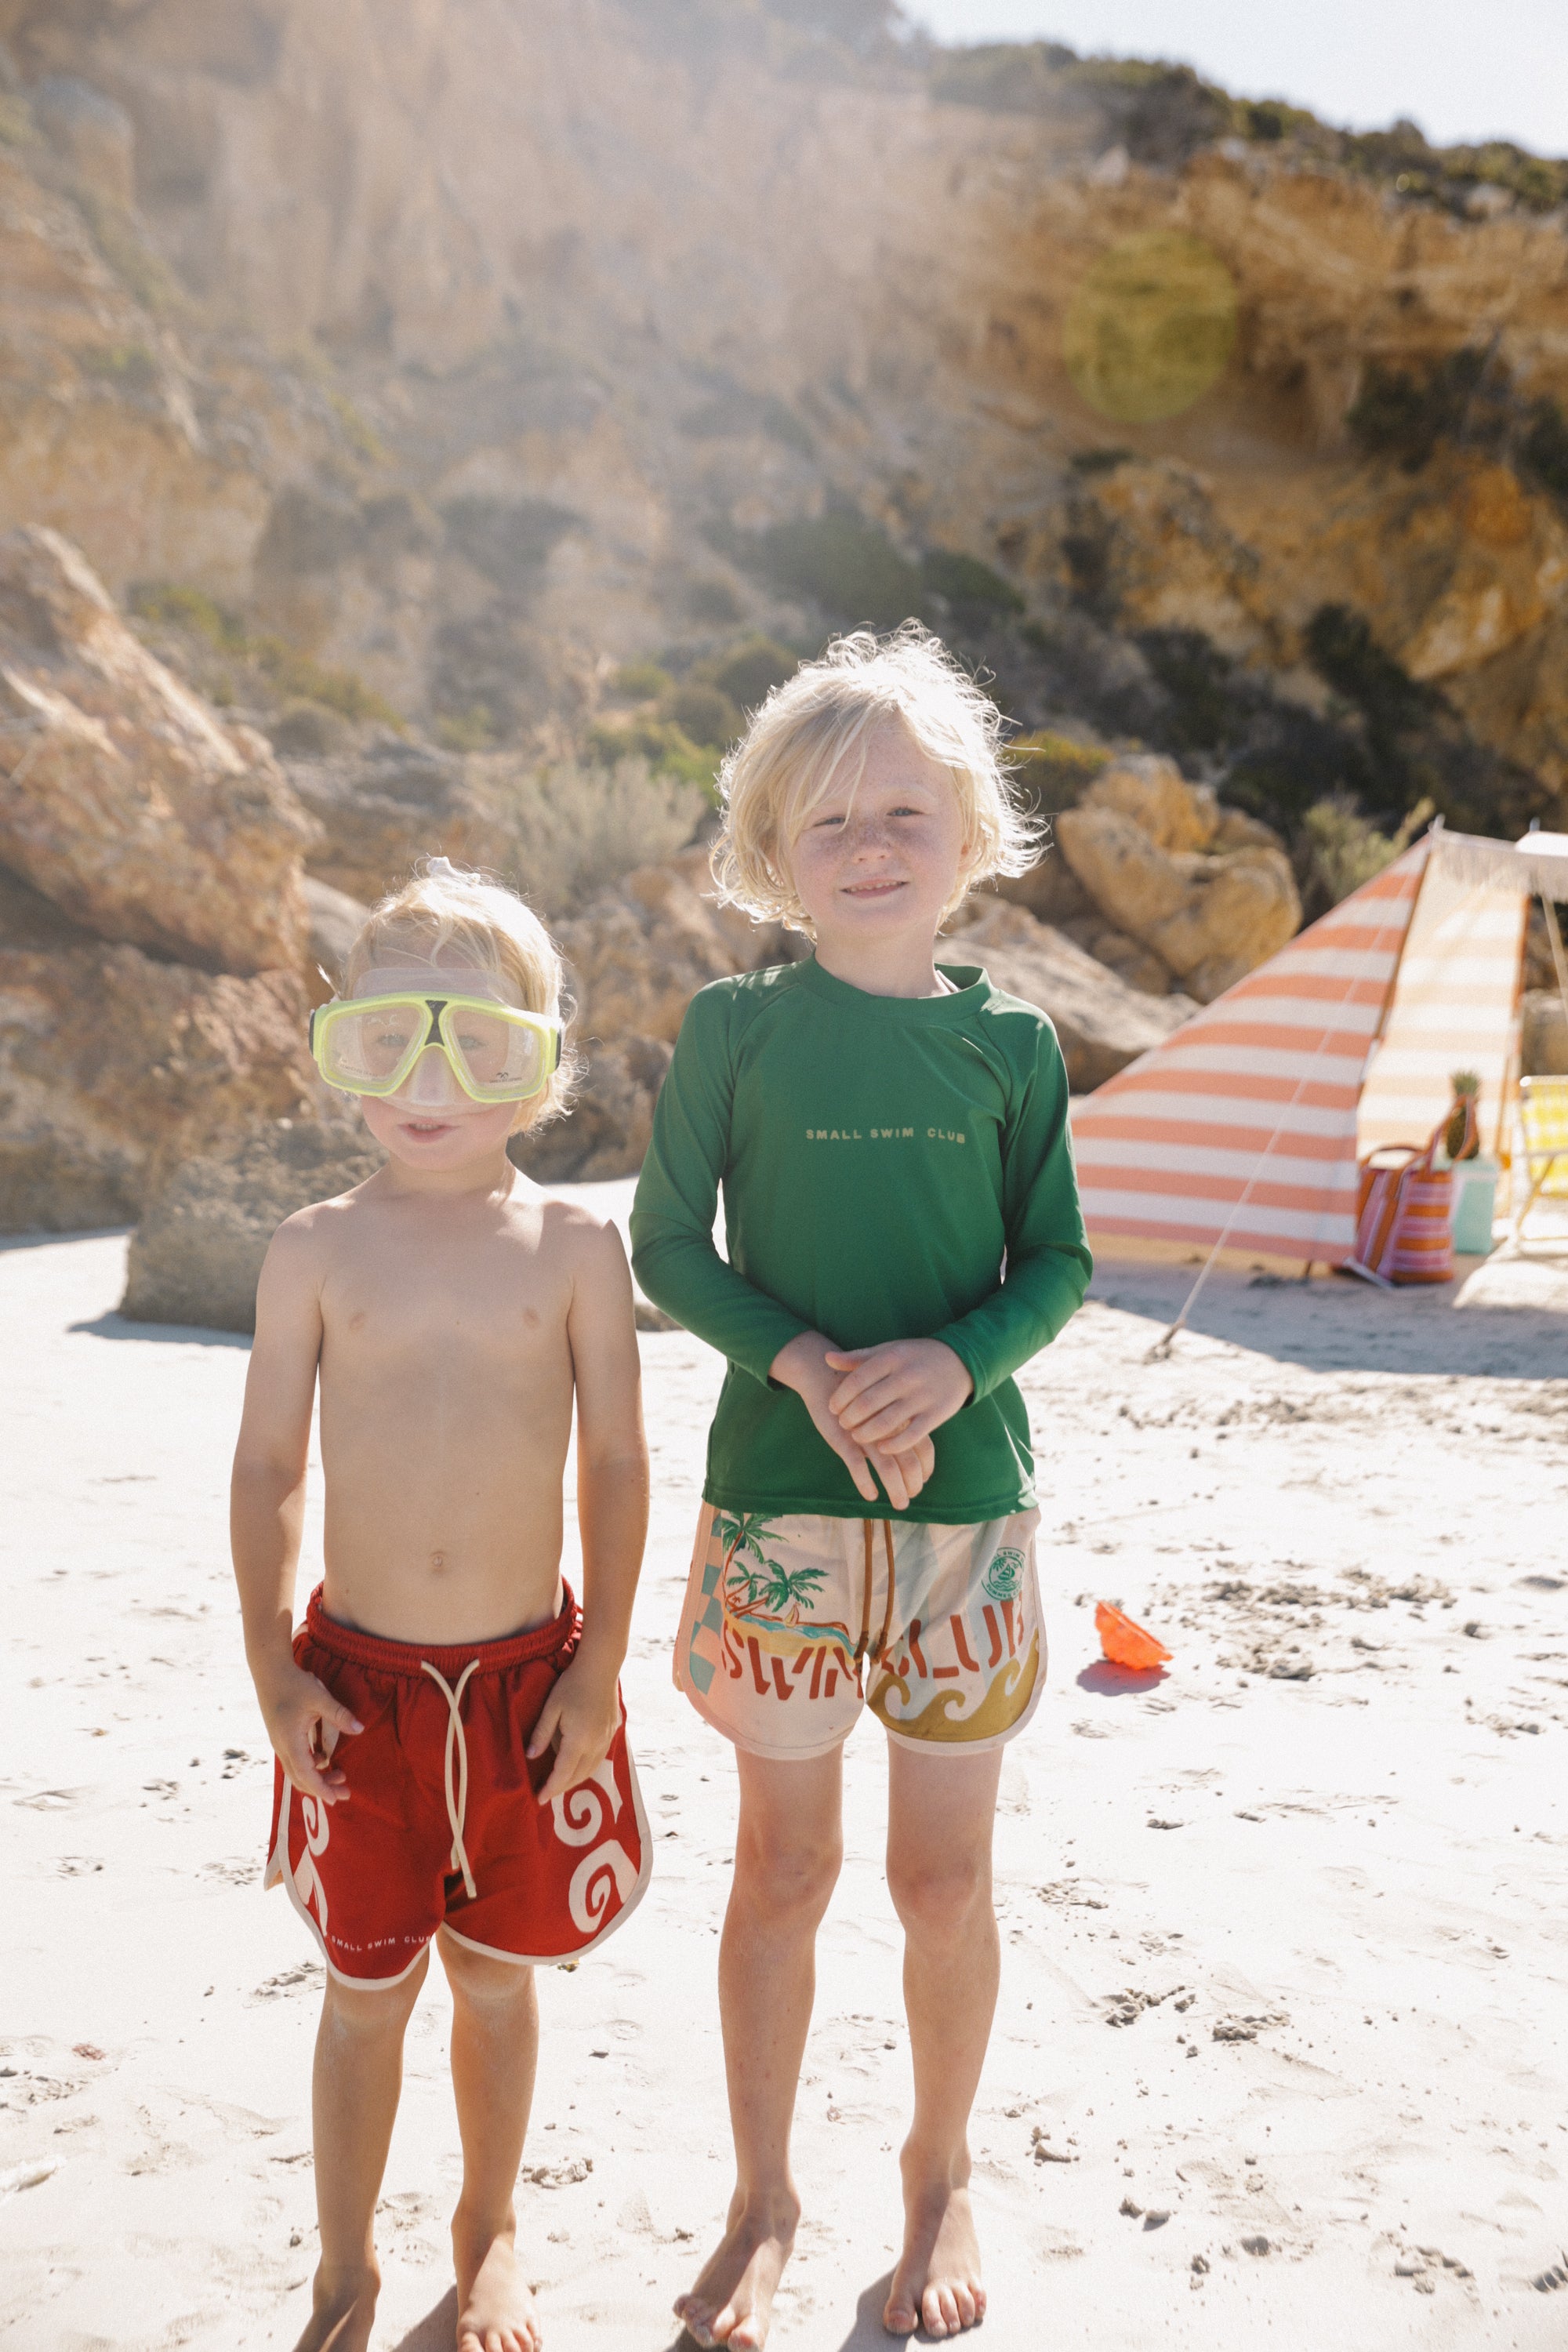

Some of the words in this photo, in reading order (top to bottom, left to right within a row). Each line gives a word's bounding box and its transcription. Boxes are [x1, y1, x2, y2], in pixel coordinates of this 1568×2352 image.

[806, 1129, 861, 1140] SMALL
[870, 1127, 914, 1138] SWIM
[927, 1127, 965, 1143] CLUB
[332, 1935, 362, 1951] SMALL
[368, 1937, 395, 1950] SWIM
